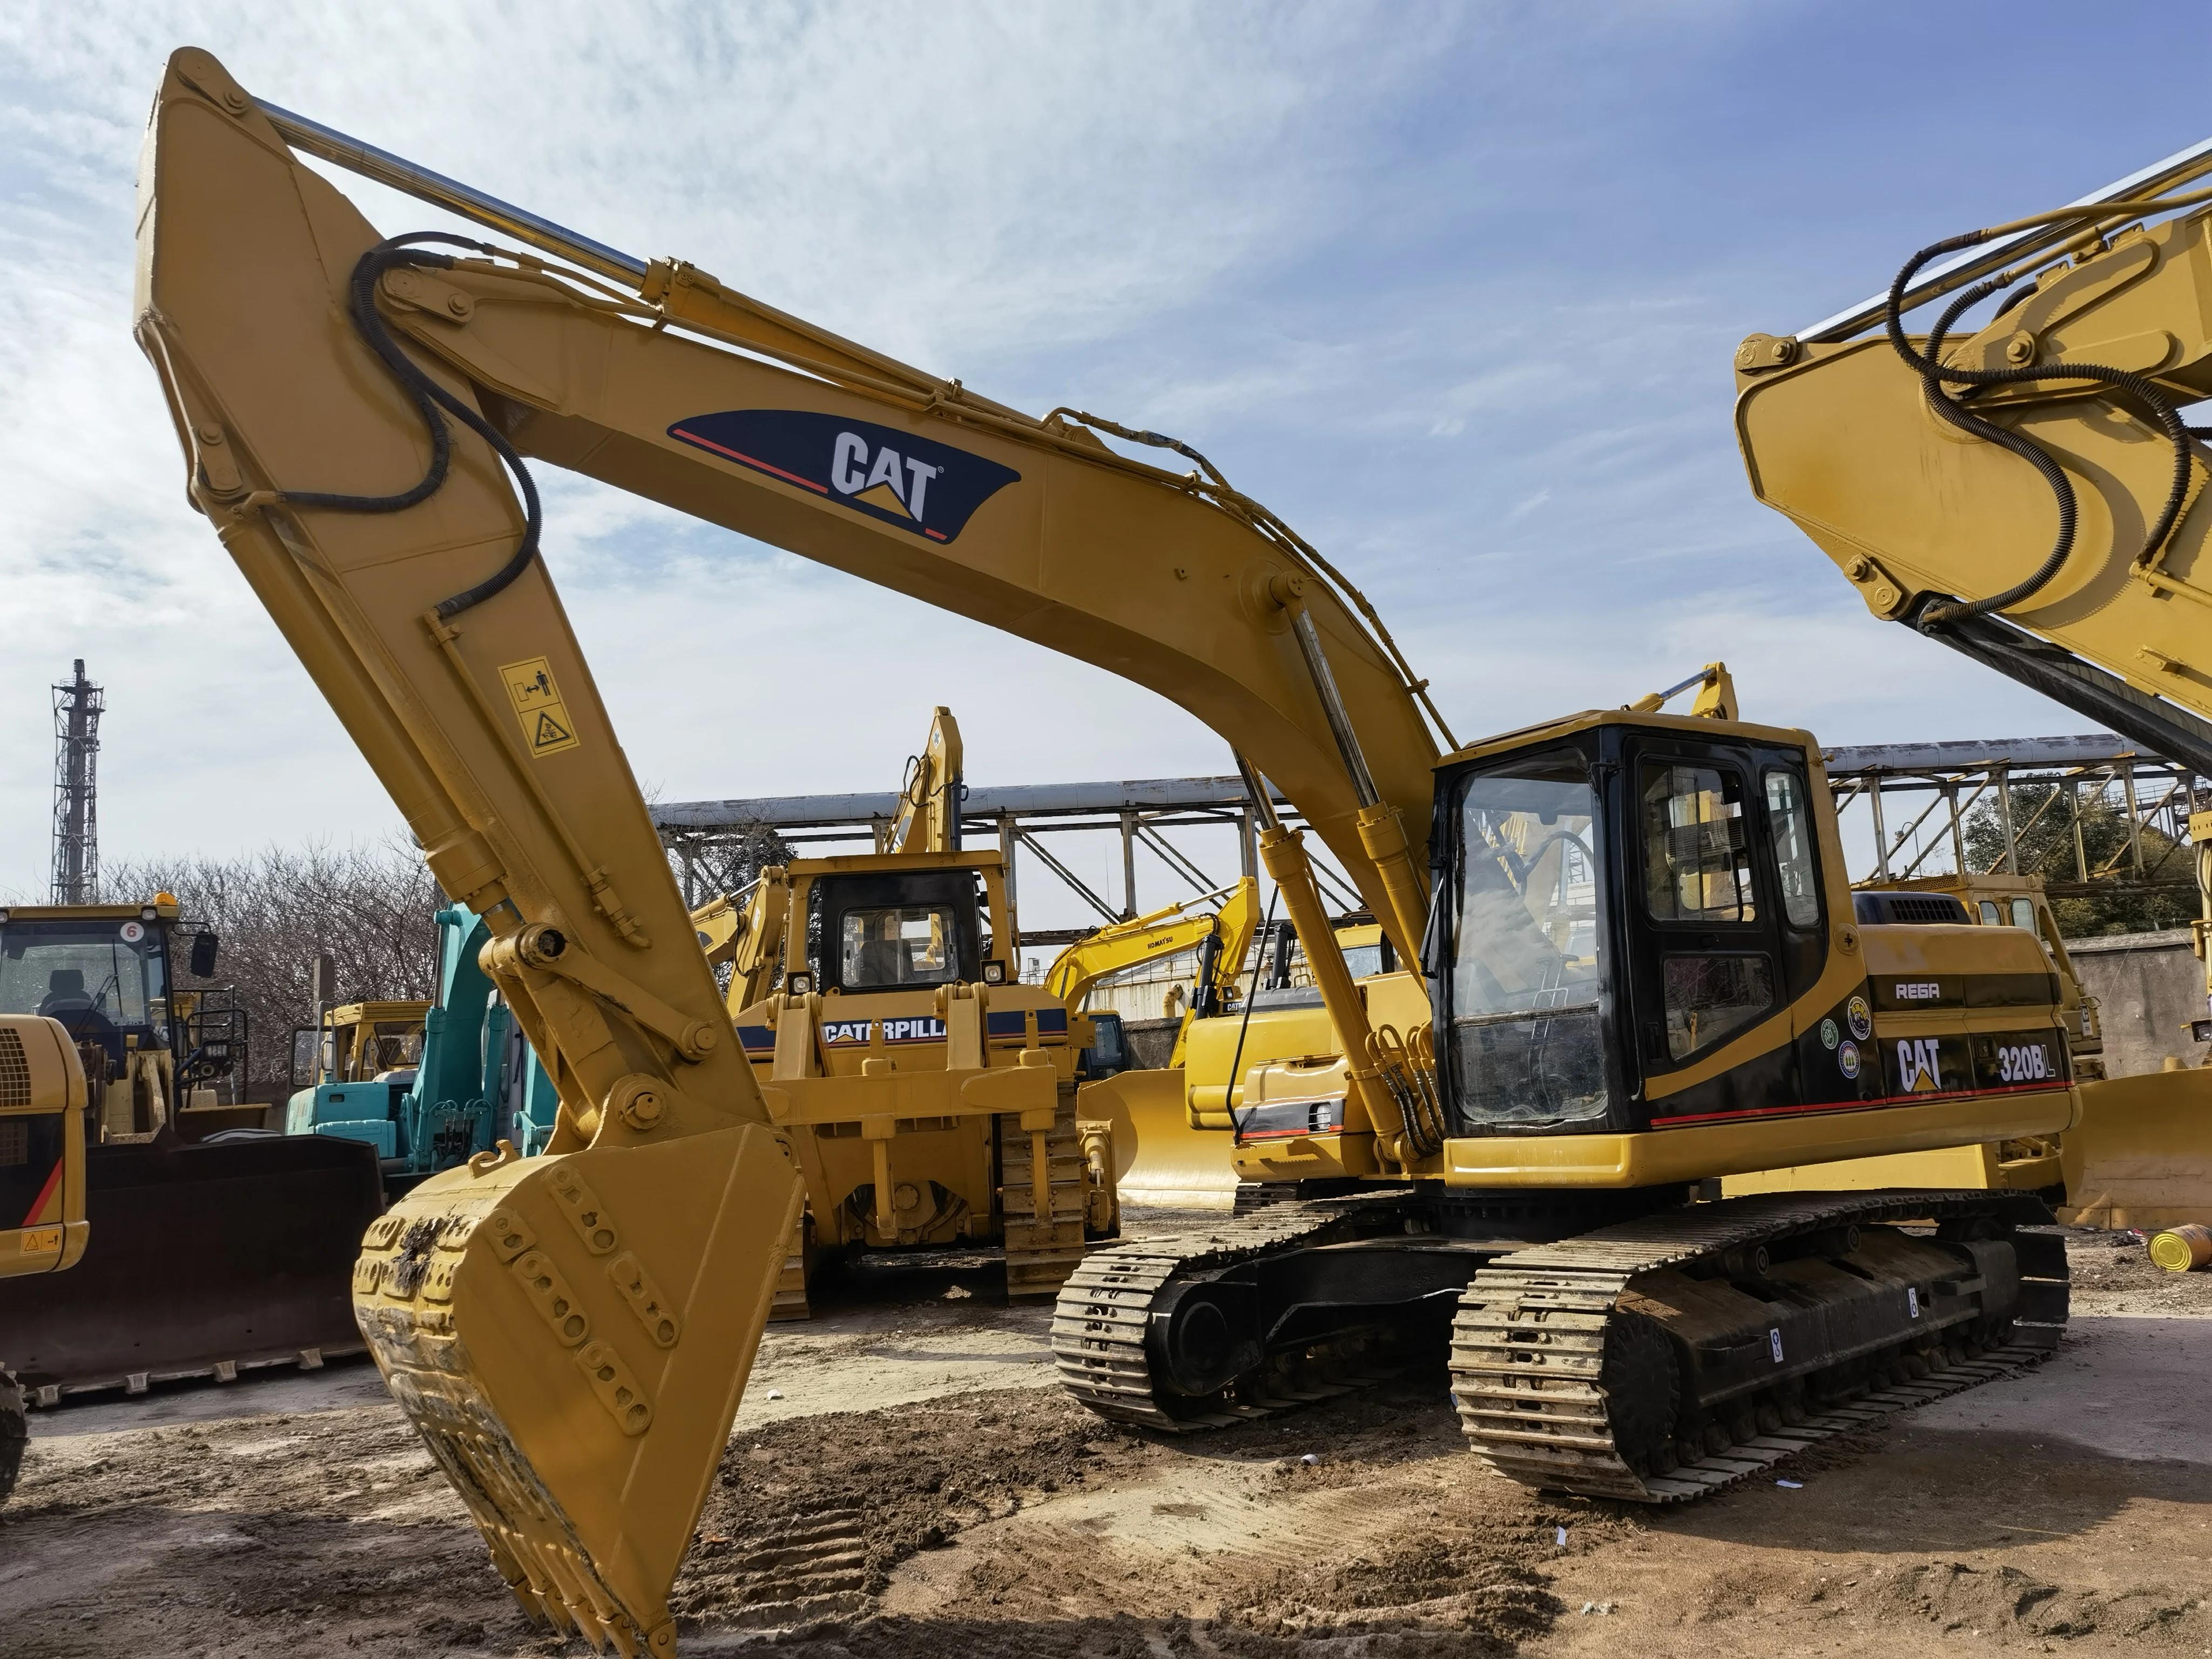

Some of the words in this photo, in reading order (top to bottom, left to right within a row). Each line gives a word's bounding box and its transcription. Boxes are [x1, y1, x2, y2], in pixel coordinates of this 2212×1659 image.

[832, 432, 937, 523] CAT
[127, 926, 137, 938] 6
[1148, 936, 1173, 949] KOMATSU
[1896, 983, 1940, 999] REGA
[1228, 1003, 1241, 1011] CAT
[824, 1020, 947, 1043] CATRPILL
[1897, 1039, 1941, 1092] CAT
[1999, 1044, 2055, 1081] 320BL
